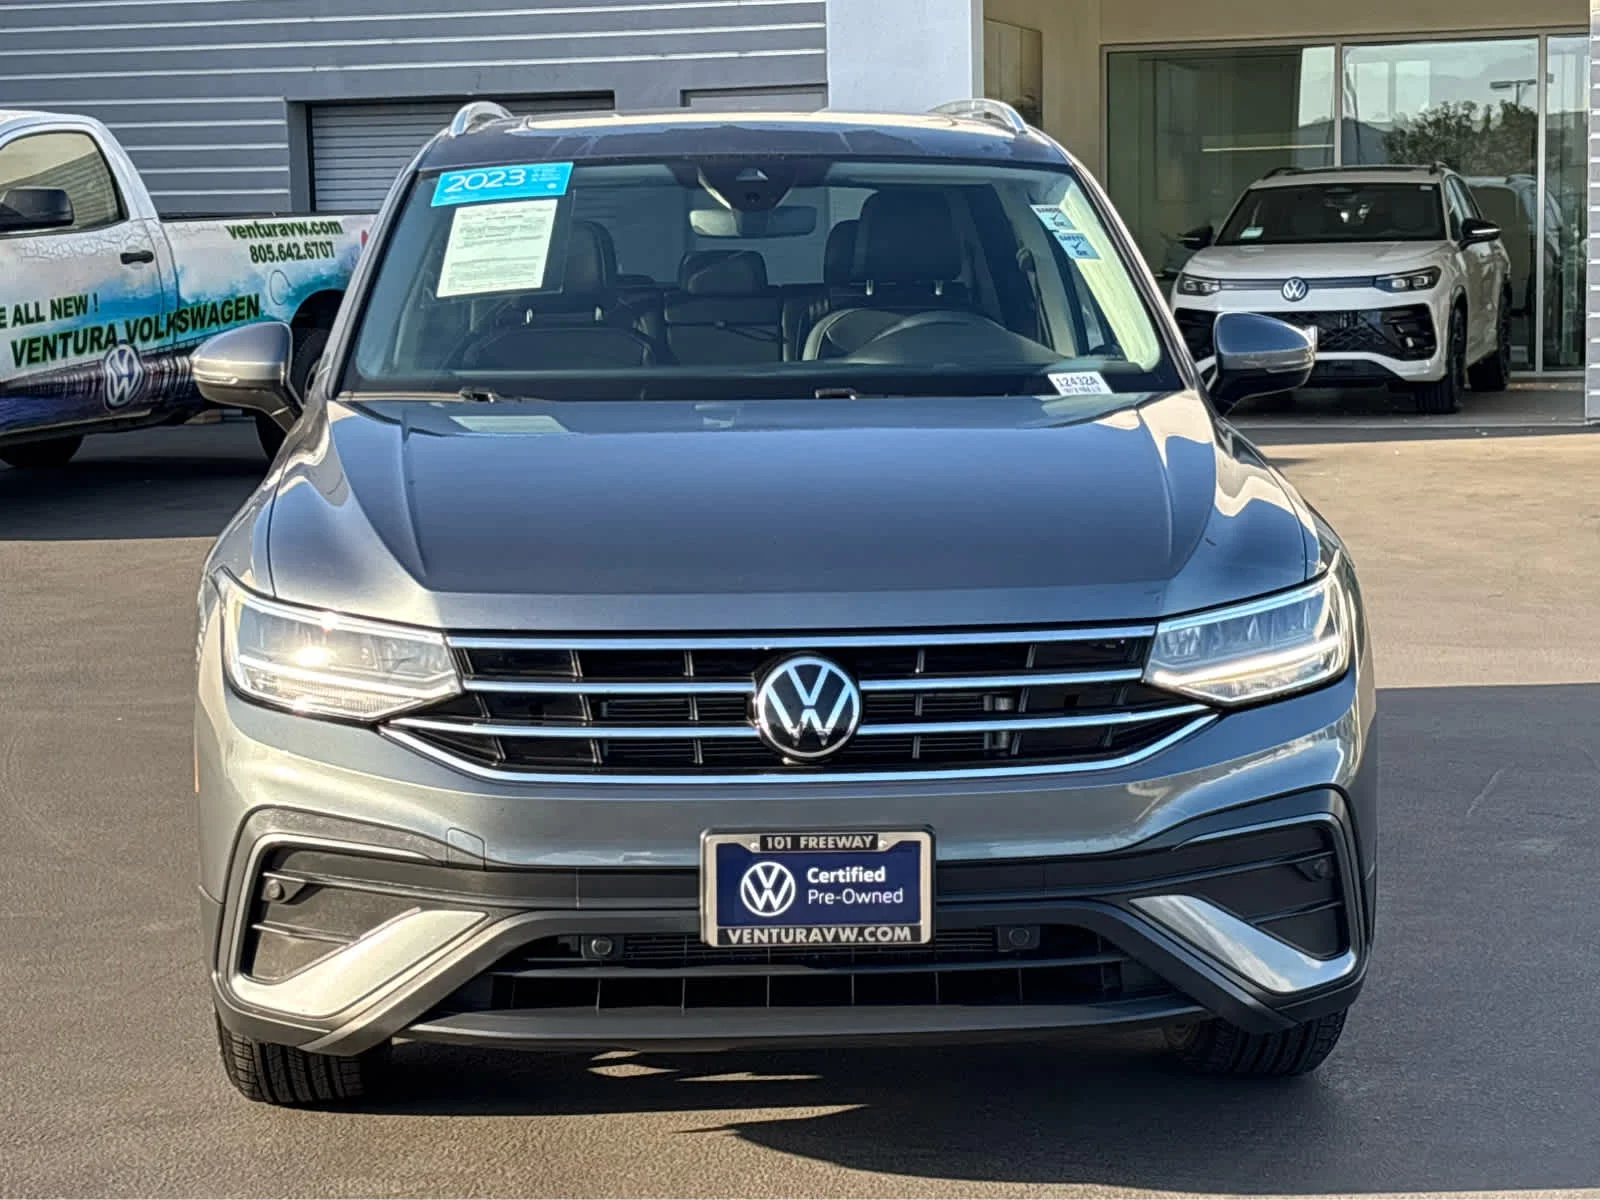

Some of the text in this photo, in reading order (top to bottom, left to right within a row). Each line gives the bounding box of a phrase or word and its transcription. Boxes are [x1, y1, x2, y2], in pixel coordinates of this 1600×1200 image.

[444, 168, 527, 193] 2023
[226, 220, 344, 240] venturavw.com
[249, 241, 335, 264] 805.642.6707
[1283, 278, 1307, 299] VW
[11, 301, 46, 328] ALL
[50, 293, 88, 320] NEW
[10, 294, 260, 368] VENTURA VOLKSWAGEN
[758, 656, 860, 757] VW
[766, 835, 874, 849] 101 FREEWAY
[807, 866, 886, 884] Certified
[740, 861, 796, 917] VW
[807, 888, 904, 905] Pre-Owned
[727, 926, 912, 945] VENTURAVW.COM
